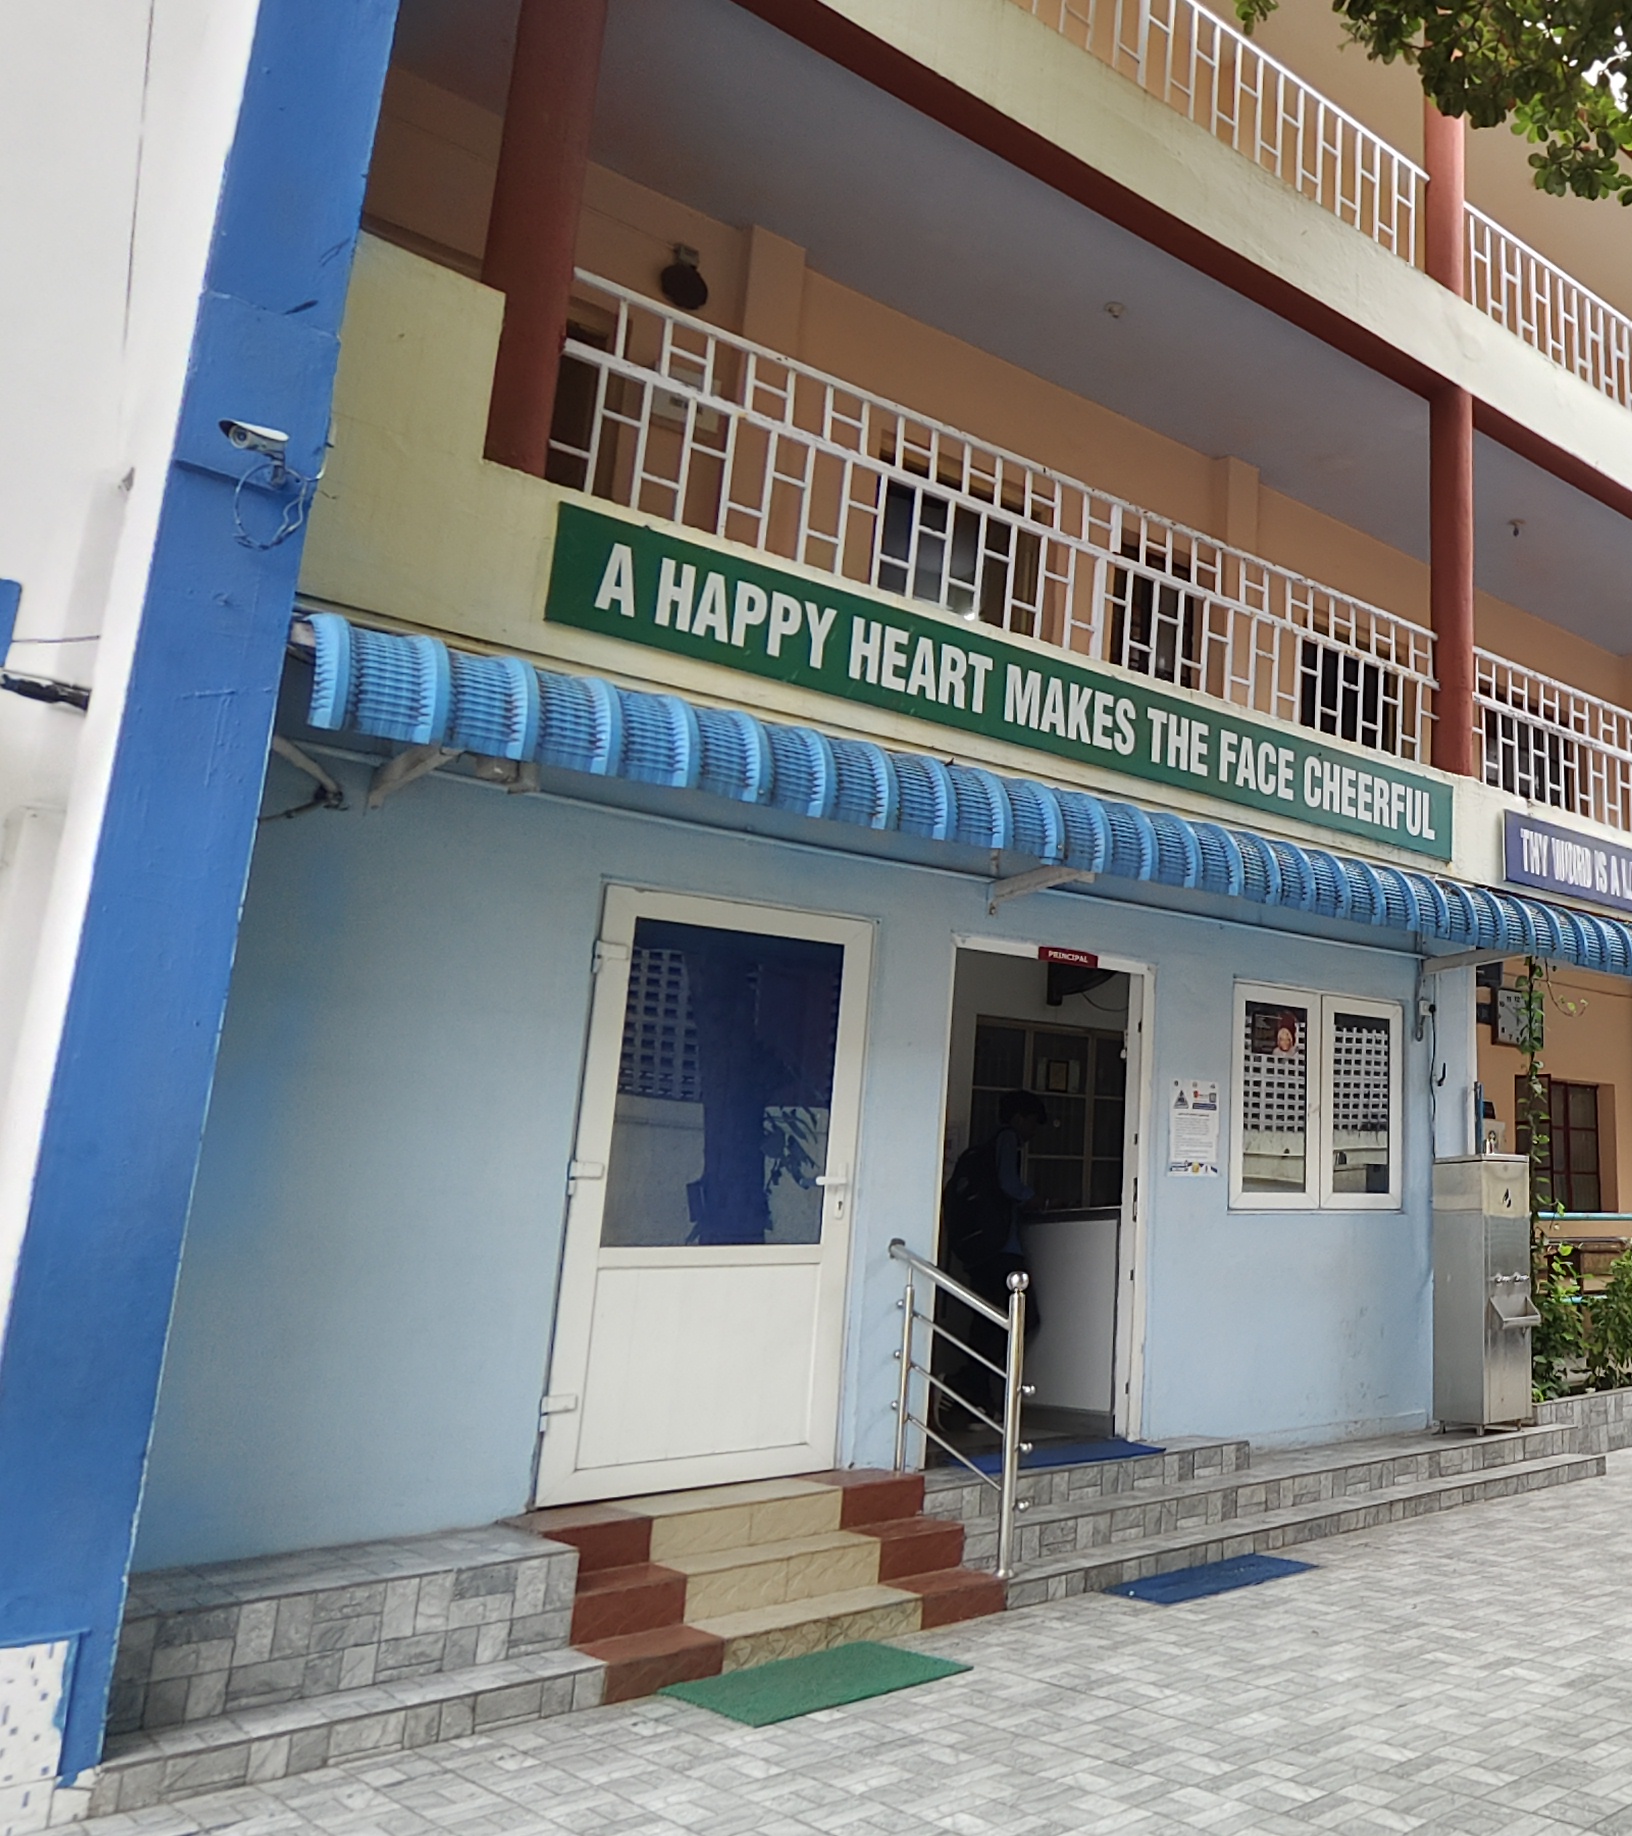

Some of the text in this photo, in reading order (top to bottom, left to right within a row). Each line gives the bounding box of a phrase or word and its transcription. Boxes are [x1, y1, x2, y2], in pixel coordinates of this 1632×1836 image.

[594, 543, 1436, 841] A HAPPY HEART MAKES THE FACE CHEERFUL
[1520, 827, 1548, 877] THY
[1551, 837, 1592, 888] WORD
[1594, 849, 1607, 893] IS
[1610, 855, 1620, 897] A
[1048, 950, 1089, 963] PRINCIPAL
